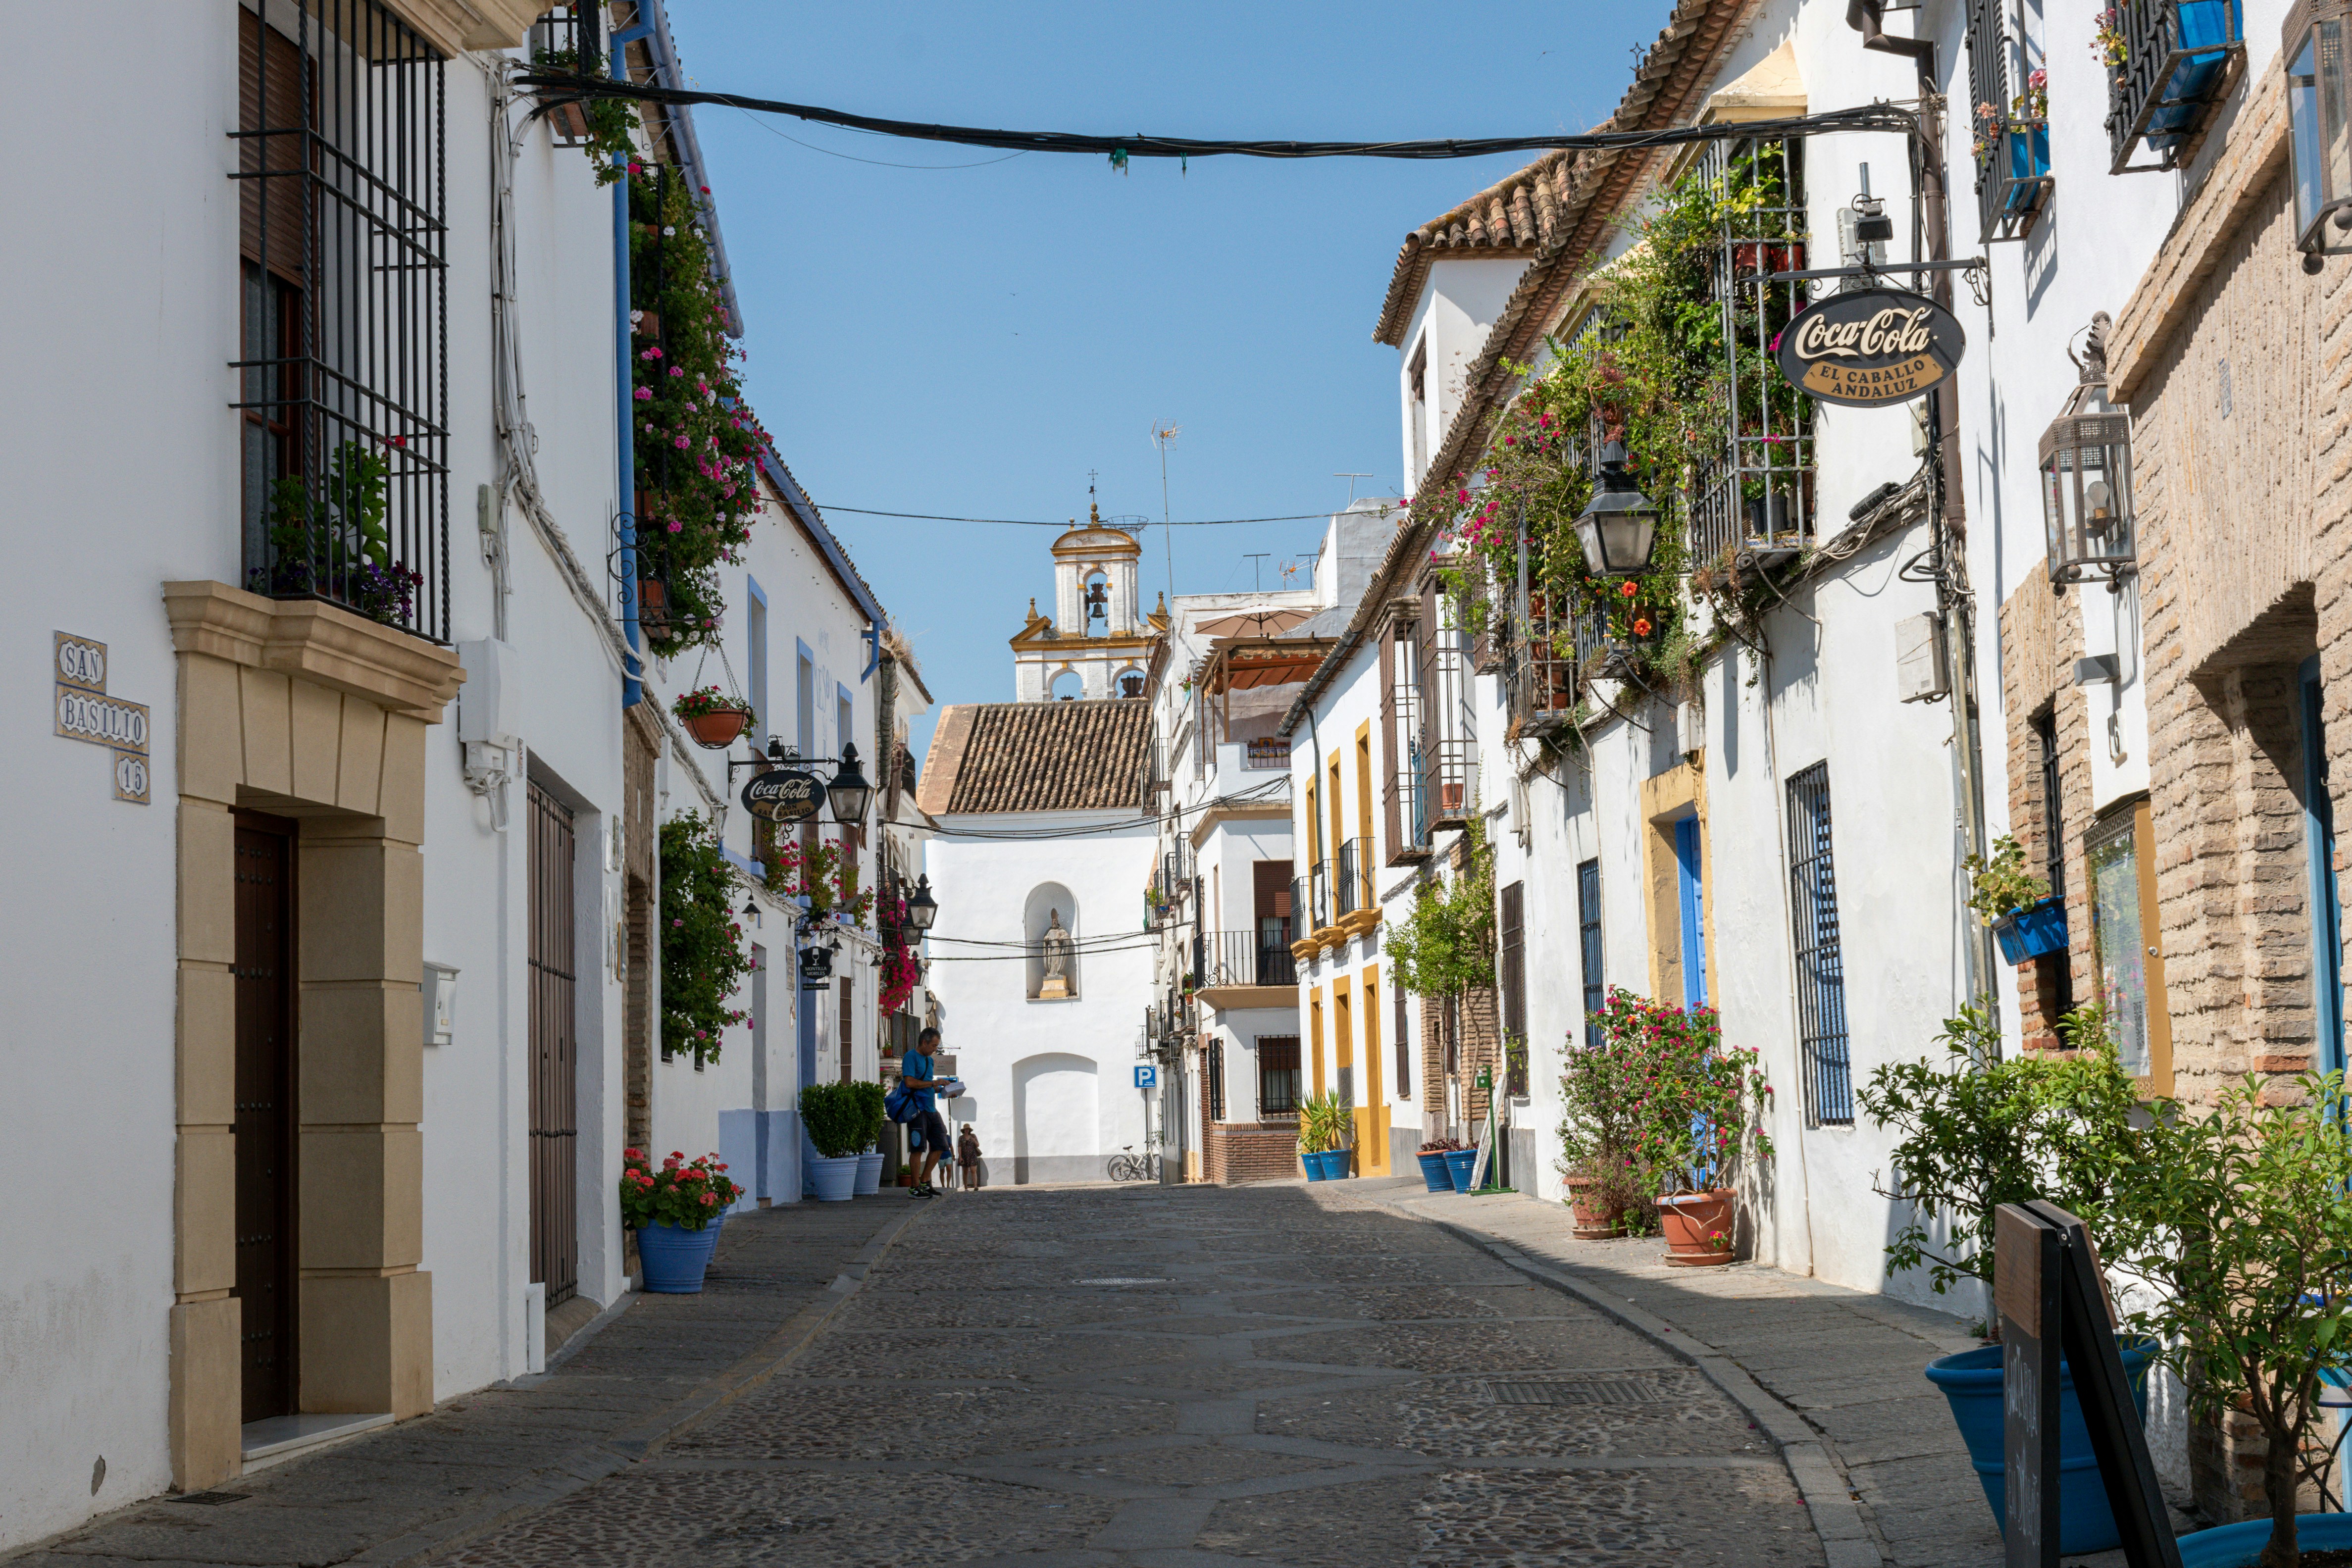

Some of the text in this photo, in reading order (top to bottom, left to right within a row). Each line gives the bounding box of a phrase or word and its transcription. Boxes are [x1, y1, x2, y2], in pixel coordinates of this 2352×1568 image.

[1795, 306, 1933, 359] Coca-Cola
[1820, 359, 1925, 384] EL CABALLO
[1832, 378, 1918, 398] ANDALUZ
[66, 646, 99, 679] SAN
[64, 698, 142, 741] BASILIO
[124, 763, 141, 790] 15
[750, 779, 813, 800] Coca-Cola
[777, 807, 811, 816] BASILIO
[1138, 1068, 1152, 1086] P
